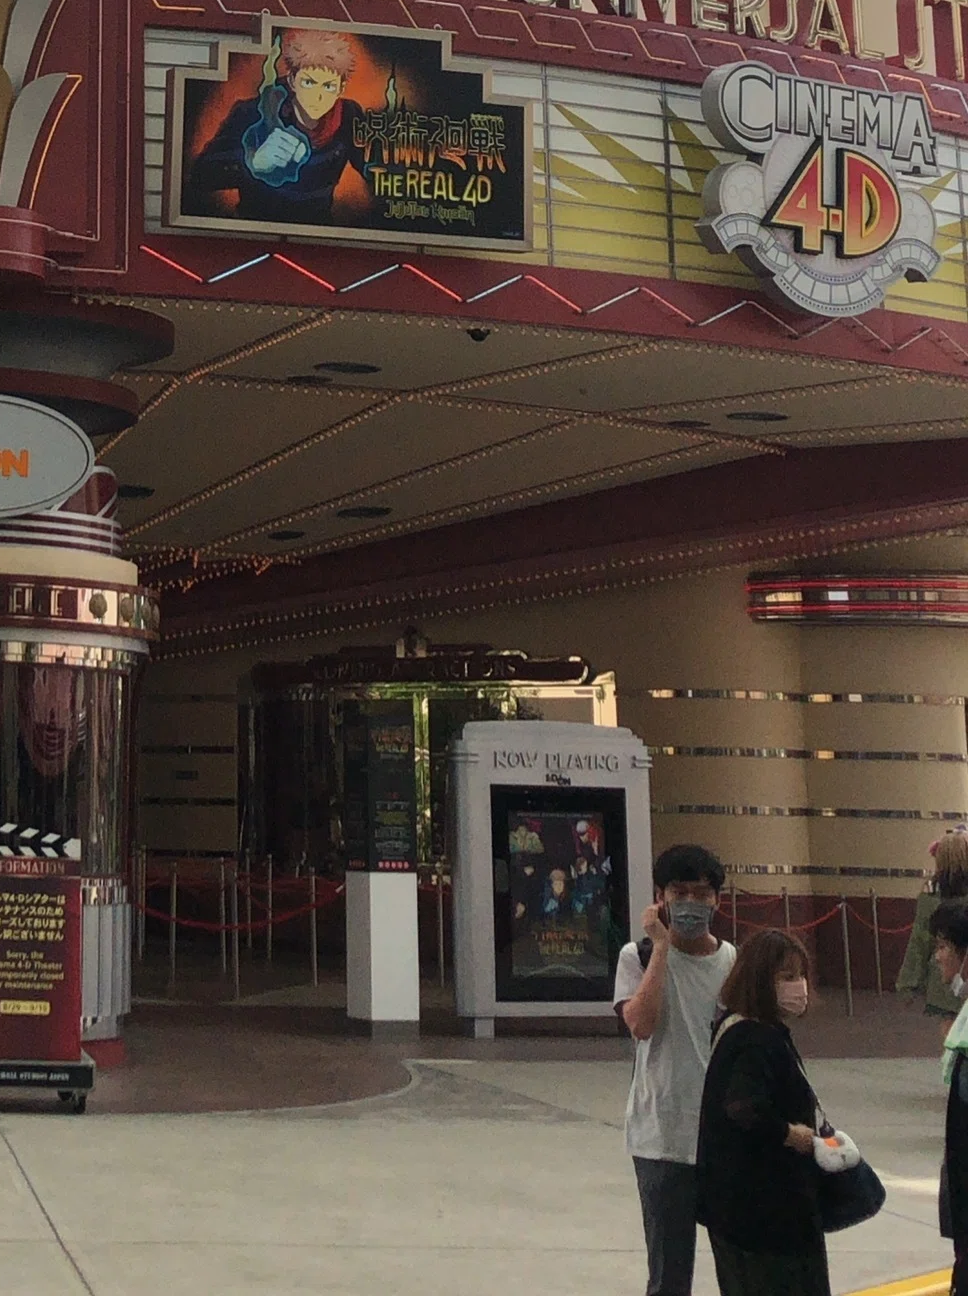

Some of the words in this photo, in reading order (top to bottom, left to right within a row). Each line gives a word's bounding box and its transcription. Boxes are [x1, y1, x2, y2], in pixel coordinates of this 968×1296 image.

[721, 64, 937, 167] CINEMA
[369, 167, 403, 197] THE
[406, 169, 461, 202] REAL
[462, 175, 492, 207] 4D
[761, 137, 902, 260] 4-D
[493, 750, 538, 769] NOW
[545, 752, 620, 772] PLAYING
